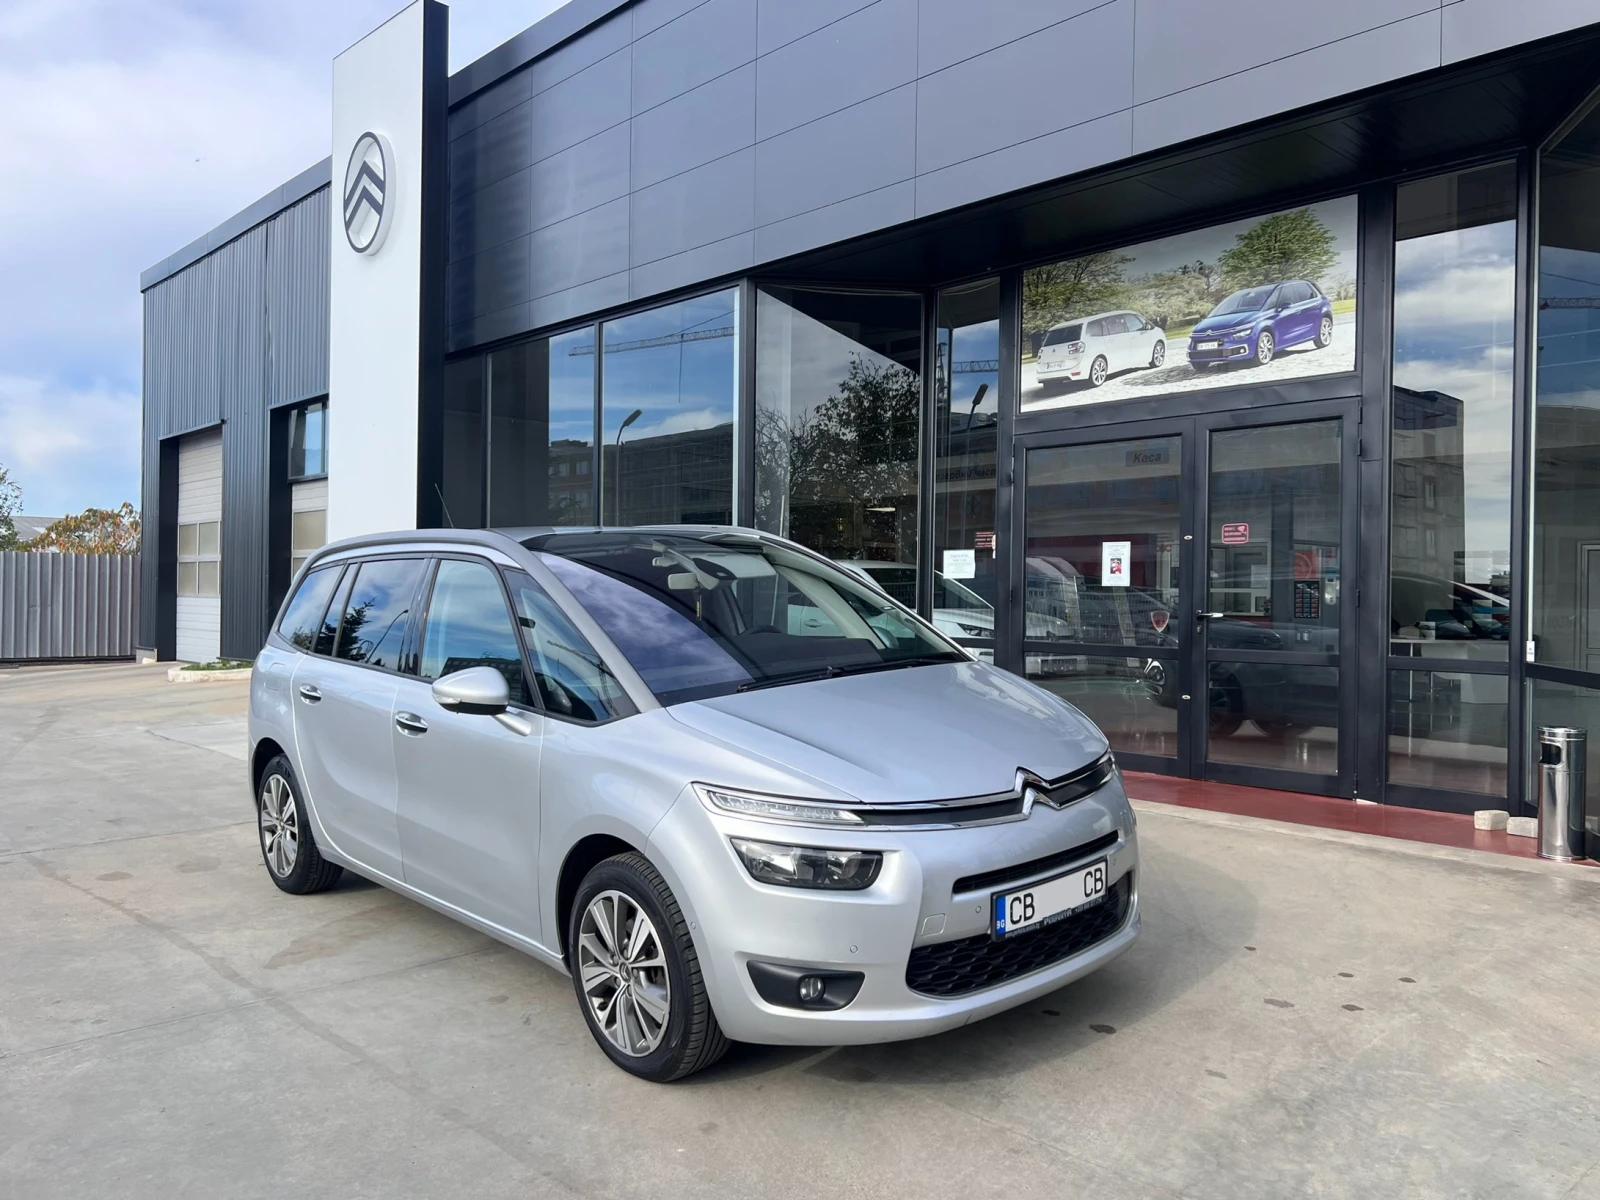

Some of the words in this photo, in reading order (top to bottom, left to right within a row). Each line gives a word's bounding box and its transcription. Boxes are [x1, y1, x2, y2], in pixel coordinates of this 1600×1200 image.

[1133, 453, 1162, 464] Каса
[1010, 893, 1035, 925] CB
[1084, 867, 1103, 897] CB
[996, 919, 1005, 930] BG
